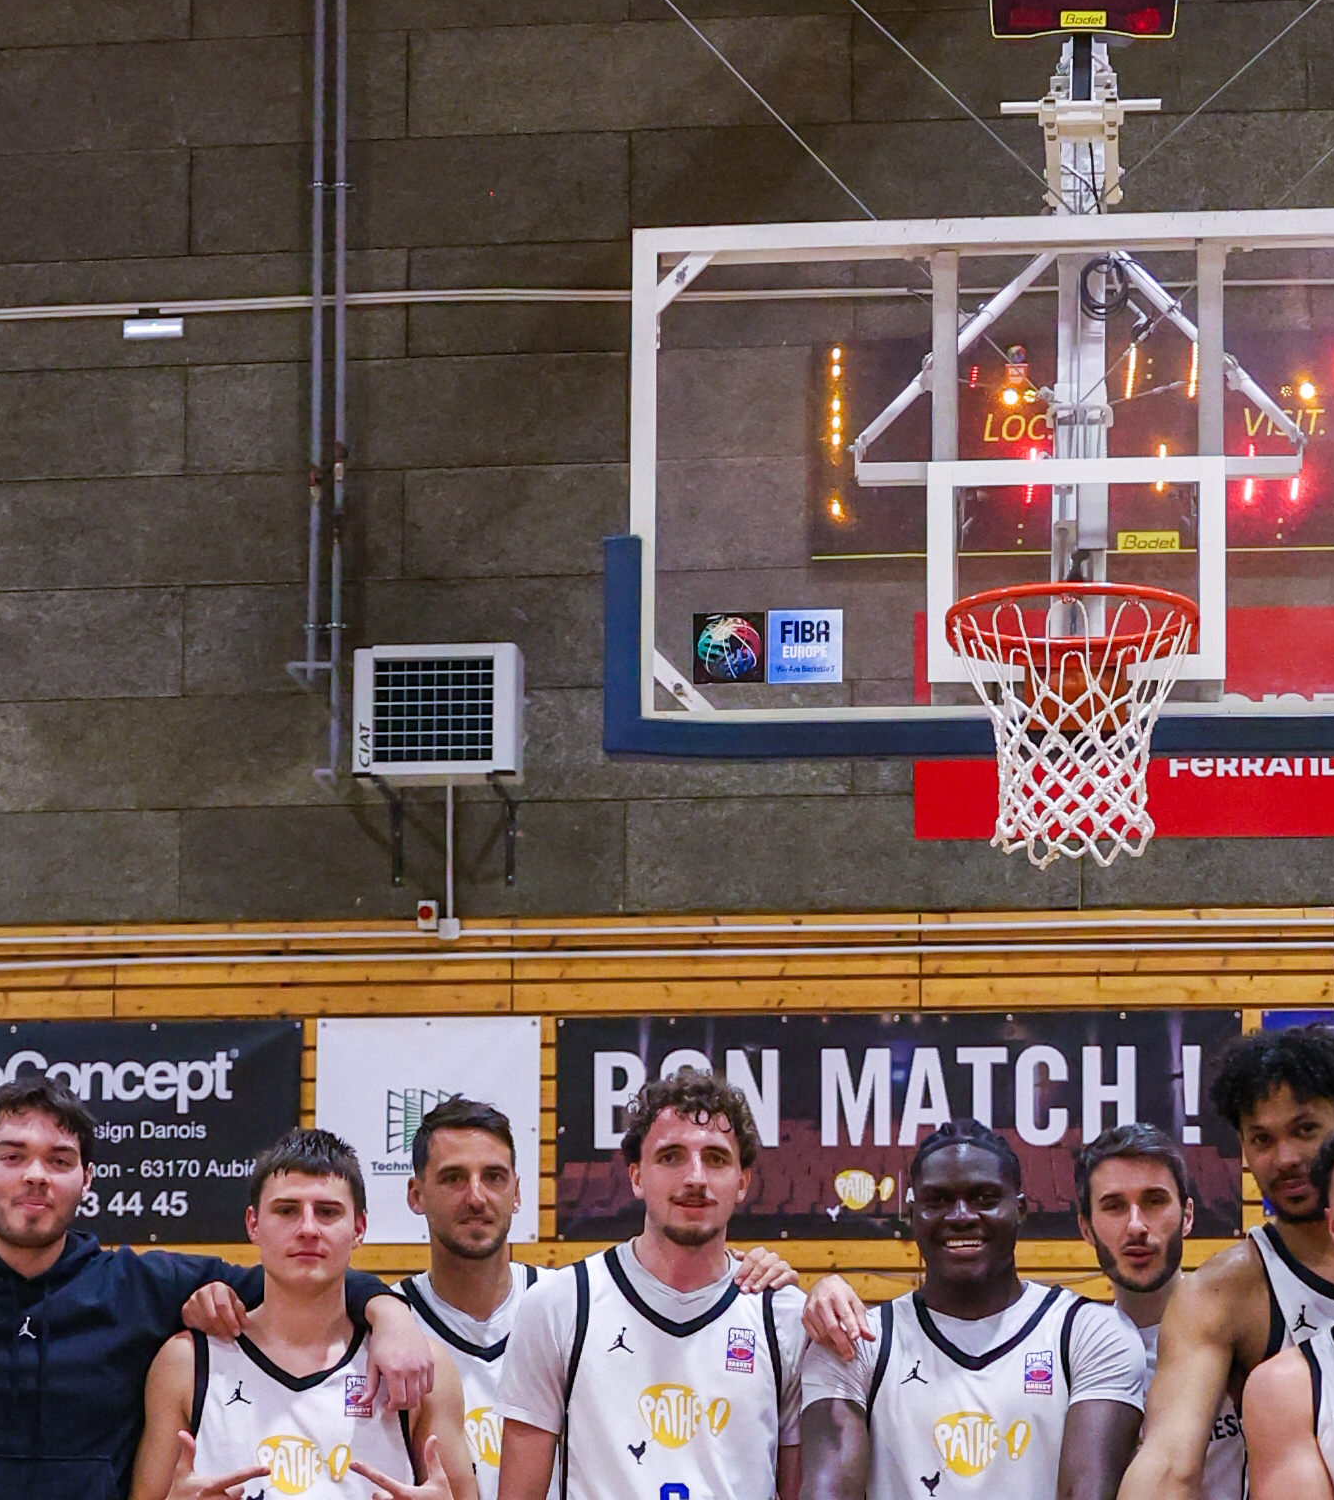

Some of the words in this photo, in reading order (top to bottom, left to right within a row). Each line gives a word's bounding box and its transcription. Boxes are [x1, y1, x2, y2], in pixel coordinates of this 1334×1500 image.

[1063, 13, 1103, 25] Bodet
[1122, 534, 1177, 551] Bodet
[780, 620, 830, 643] FIBA
[782, 645, 828, 659] EUROPE
[358, 723, 370, 768] CIAT
[820, 1044, 1137, 1147] MATCH
[140, 1121, 207, 1141] Danois
[140, 1159, 202, 1179] 63170
[107, 1190, 144, 1217] 44
[151, 1190, 189, 1217] 45
